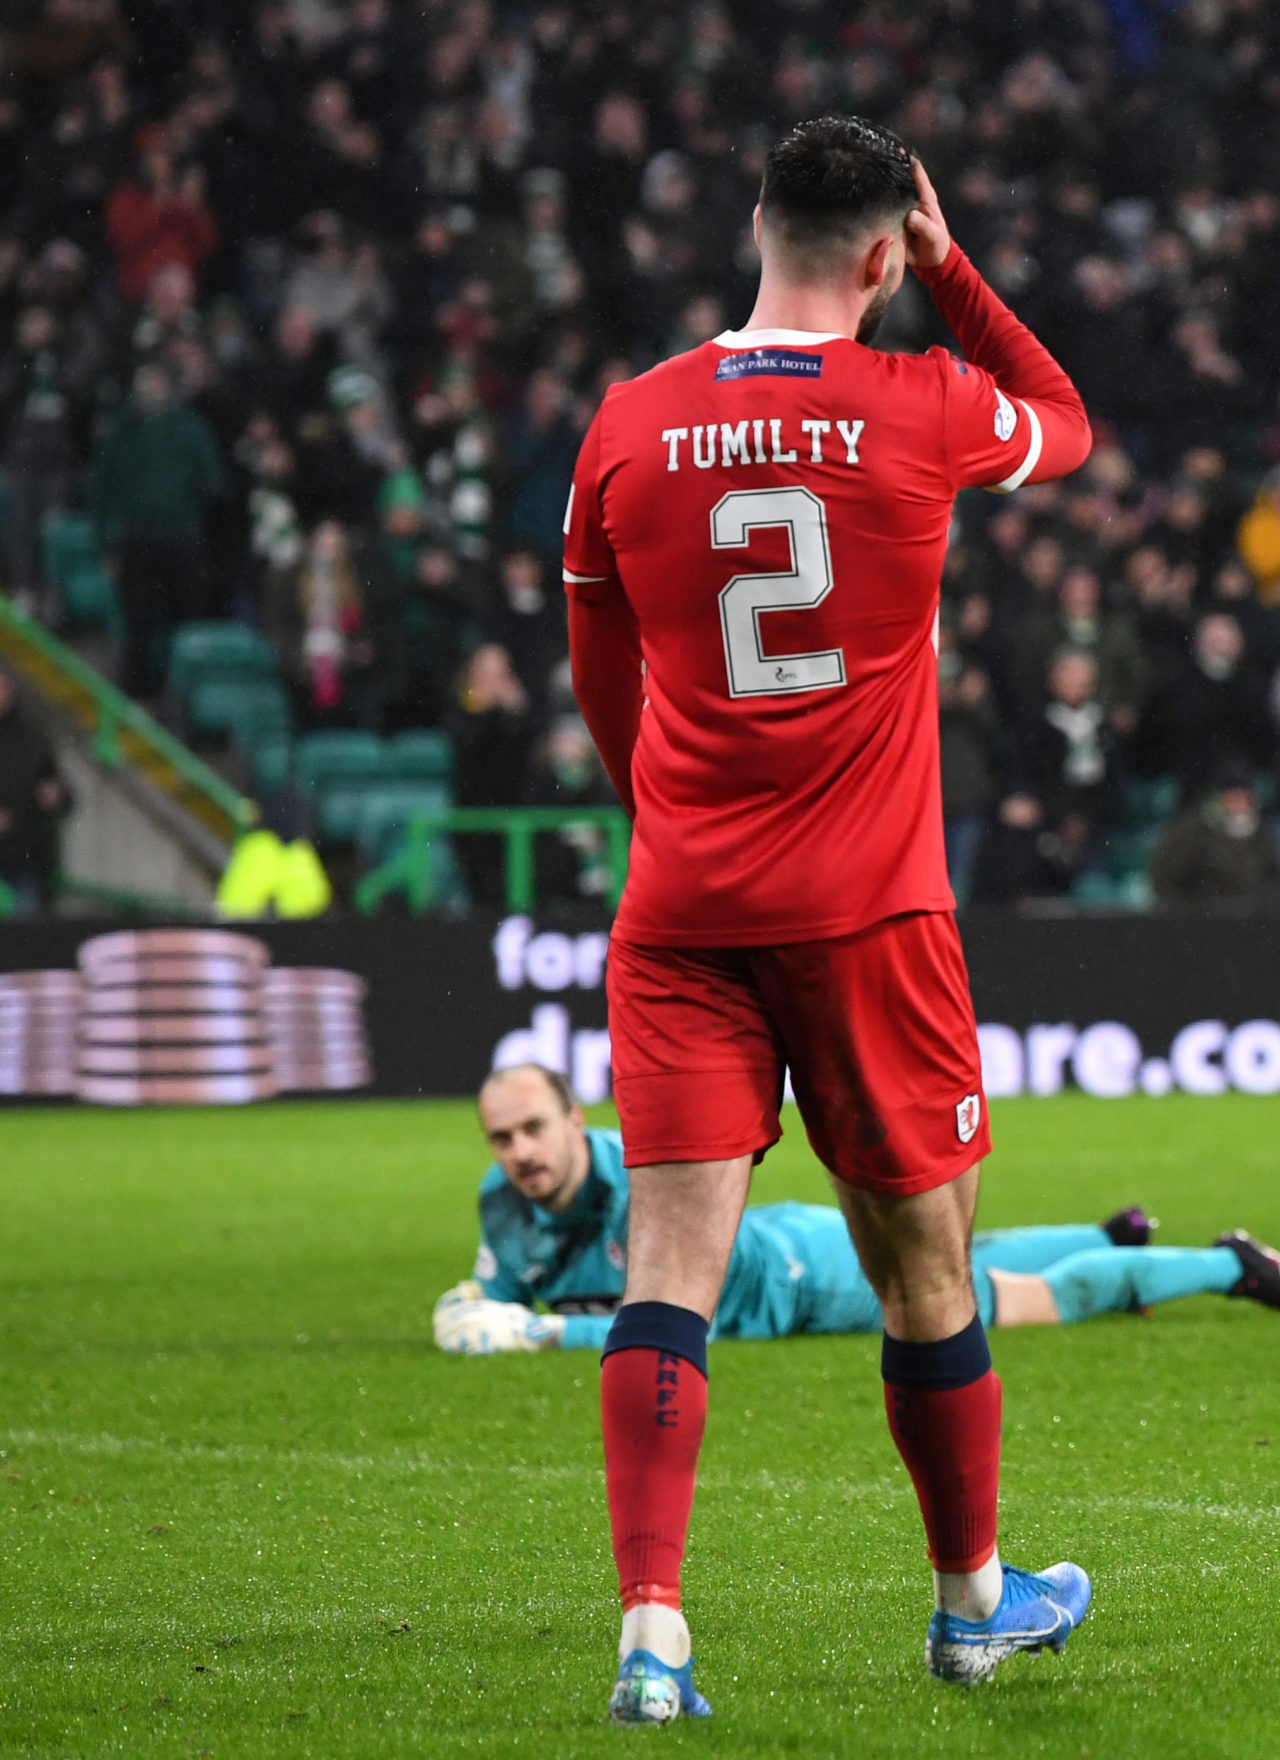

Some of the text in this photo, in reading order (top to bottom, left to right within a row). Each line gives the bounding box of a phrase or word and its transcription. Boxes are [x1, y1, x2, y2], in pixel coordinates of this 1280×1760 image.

[747, 358, 778, 370] PARK
[781, 359, 821, 372] HOTEL
[661, 419, 865, 471] TUMILTY
[709, 485, 847, 699] 2
[493, 913, 611, 991] for
